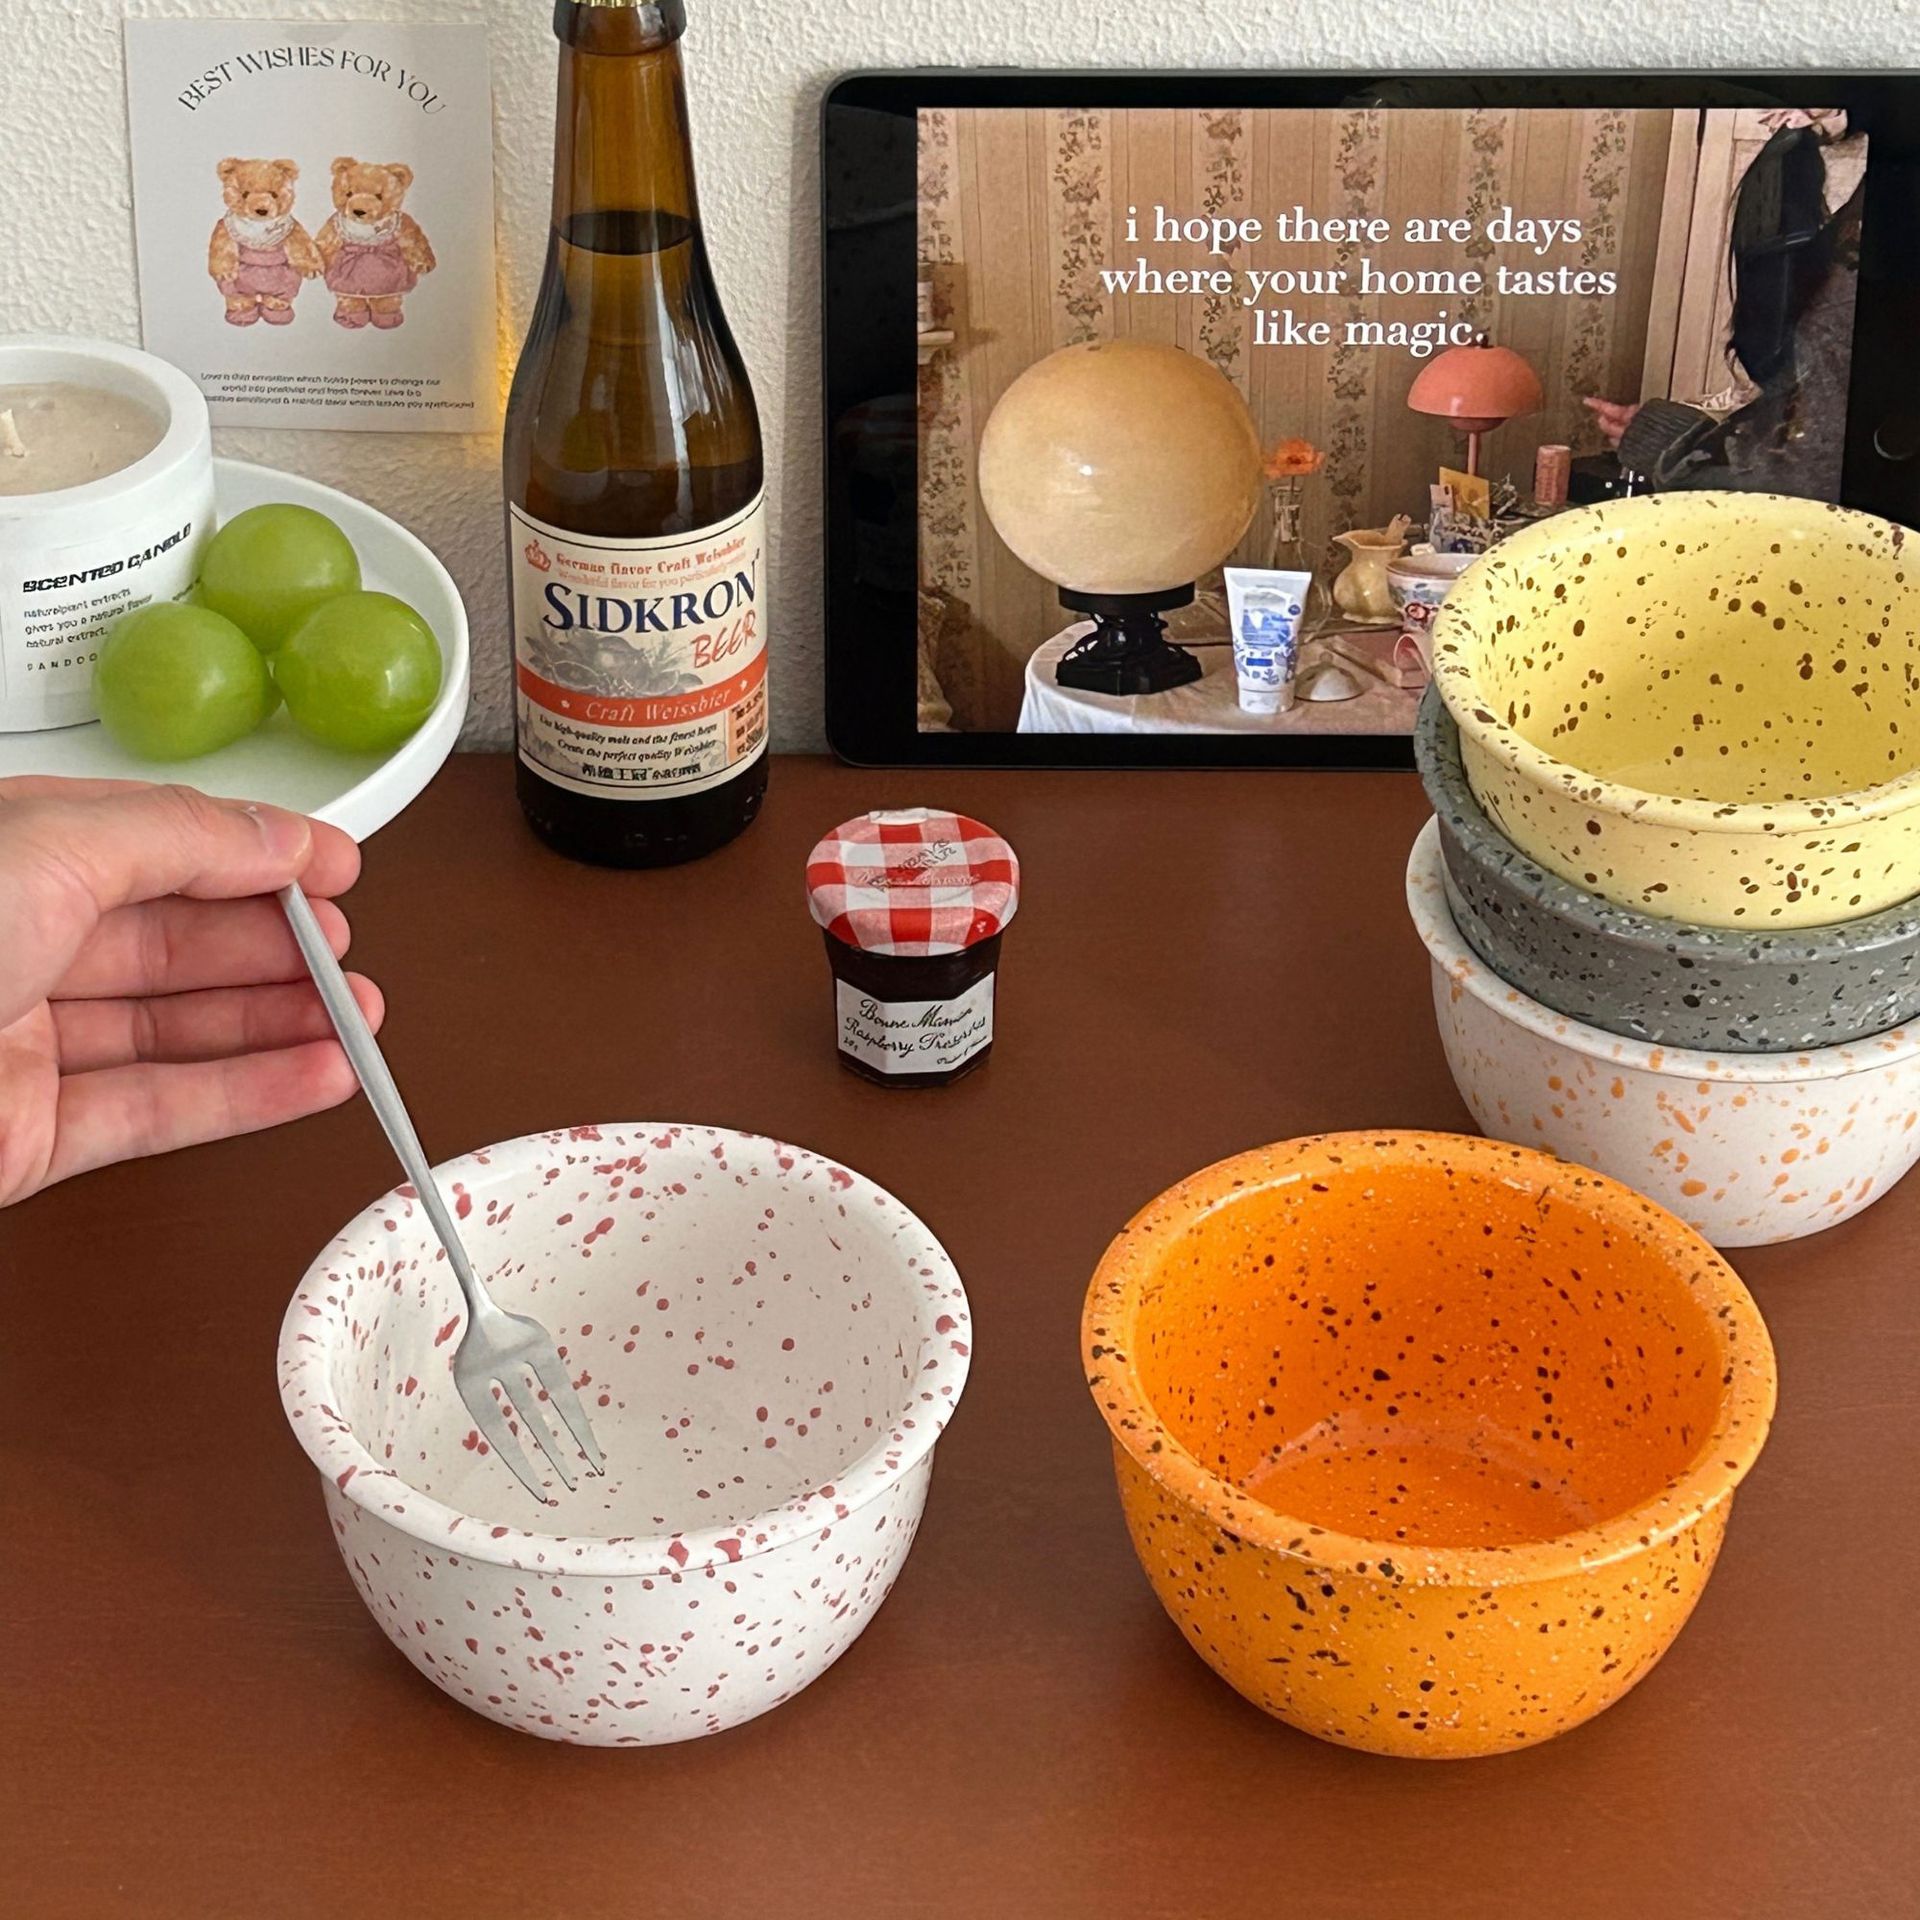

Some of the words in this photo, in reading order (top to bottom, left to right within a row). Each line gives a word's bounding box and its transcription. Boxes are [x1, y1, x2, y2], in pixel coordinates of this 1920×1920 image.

[178, 62, 232, 110] BEST
[236, 47, 335, 73] WISHES
[340, 50, 391, 81] FOR
[397, 69, 446, 114] YOU
[1125, 205, 1140, 243] i
[1153, 206, 1263, 256] hope
[1276, 206, 1391, 243] there
[1403, 214, 1473, 243] are
[1486, 206, 1582, 255] days
[1099, 258, 1233, 296] where
[1245, 267, 1347, 306] your
[1359, 258, 1482, 296] home
[1496, 266, 1618, 296] tastes
[1253, 309, 1331, 347] like
[1343, 310, 1486, 359] magic.
[22, 560, 124, 593] SCENTED
[542, 548, 760, 634] SIDKRON
[690, 608, 757, 669] BEER
[585, 701, 634, 722] Craft
